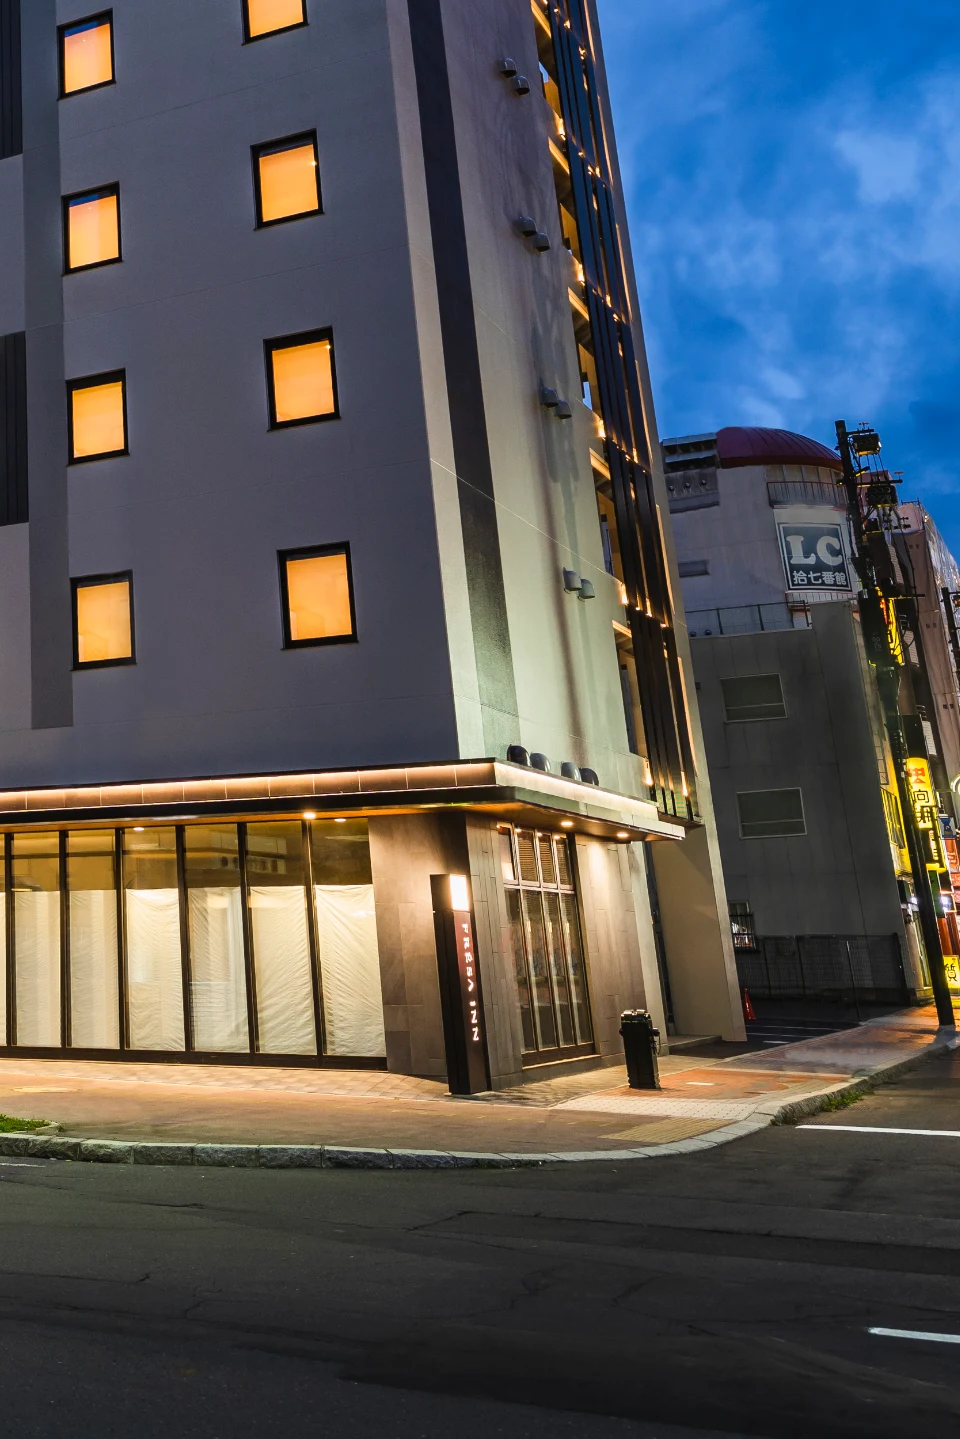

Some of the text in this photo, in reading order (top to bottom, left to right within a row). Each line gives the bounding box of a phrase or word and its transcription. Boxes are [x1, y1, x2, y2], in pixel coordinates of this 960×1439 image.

[786, 534, 843, 566] LC
[792, 570, 847, 585] 拾七番館
